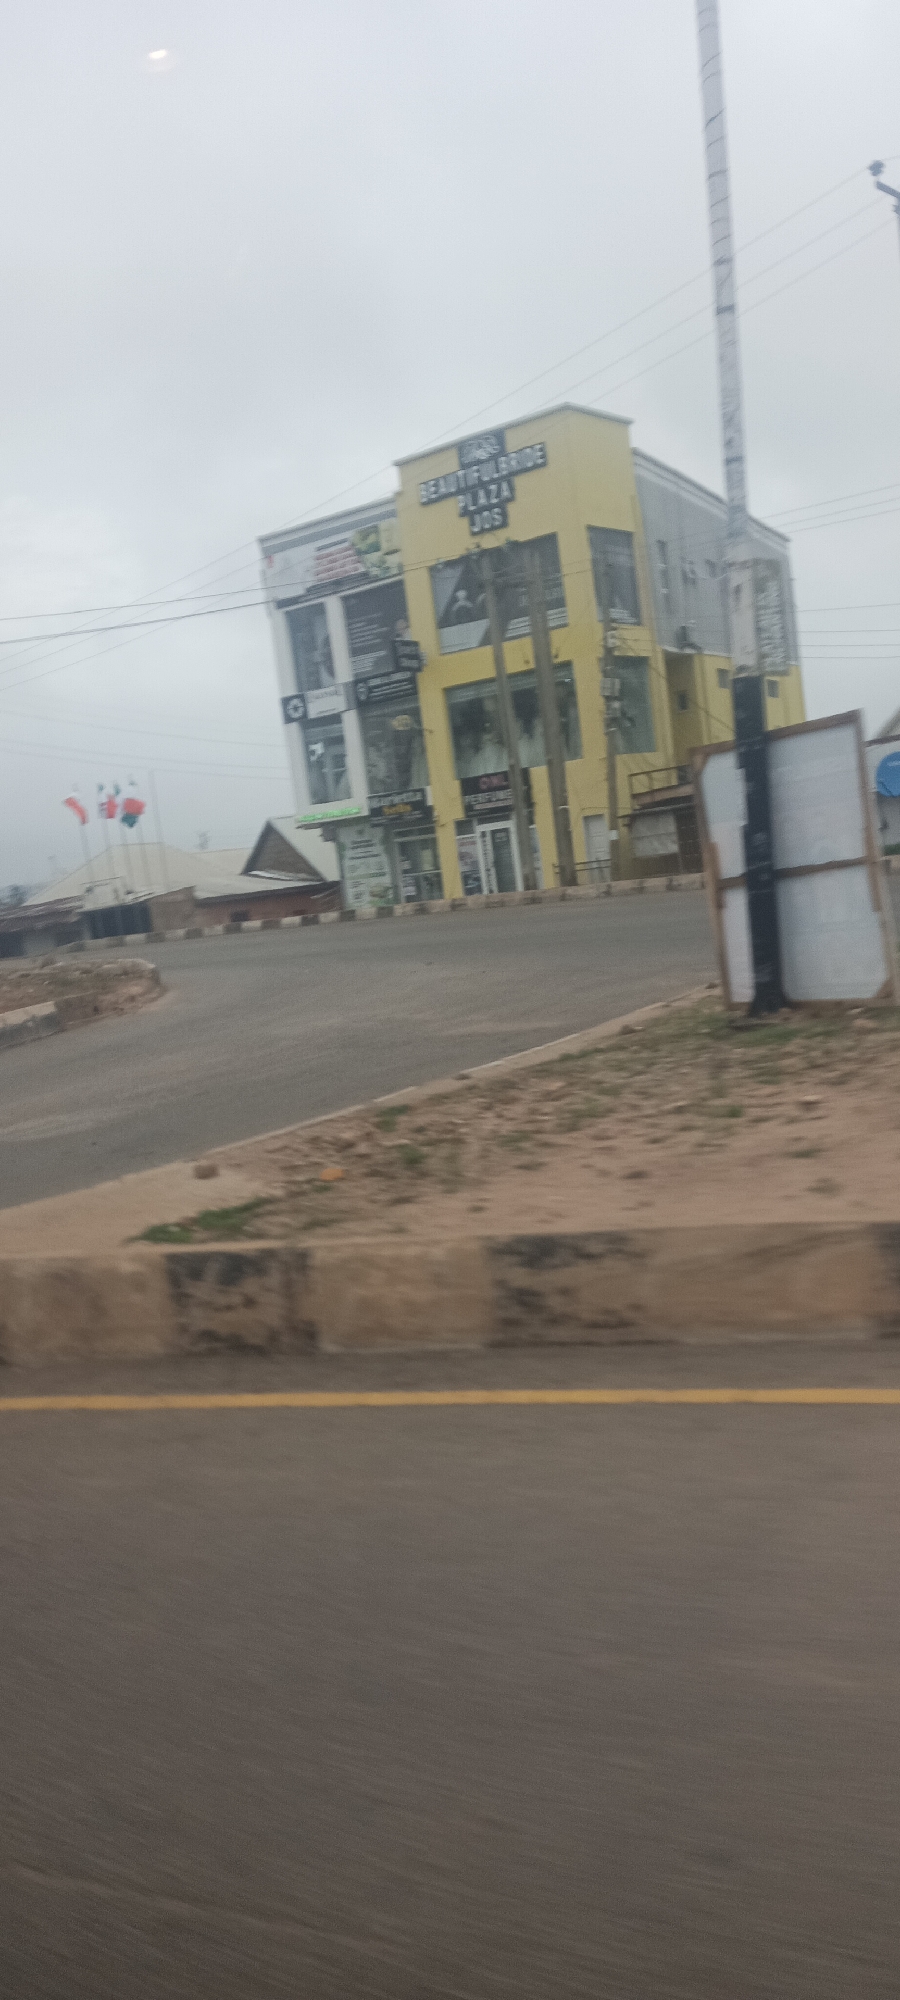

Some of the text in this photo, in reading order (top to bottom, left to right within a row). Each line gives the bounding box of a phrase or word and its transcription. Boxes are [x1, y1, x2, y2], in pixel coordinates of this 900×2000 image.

[419, 443, 545, 504] BEAUTIFULBRIDE
[458, 480, 512, 514] PLAZA
[472, 508, 503, 532] JOS
